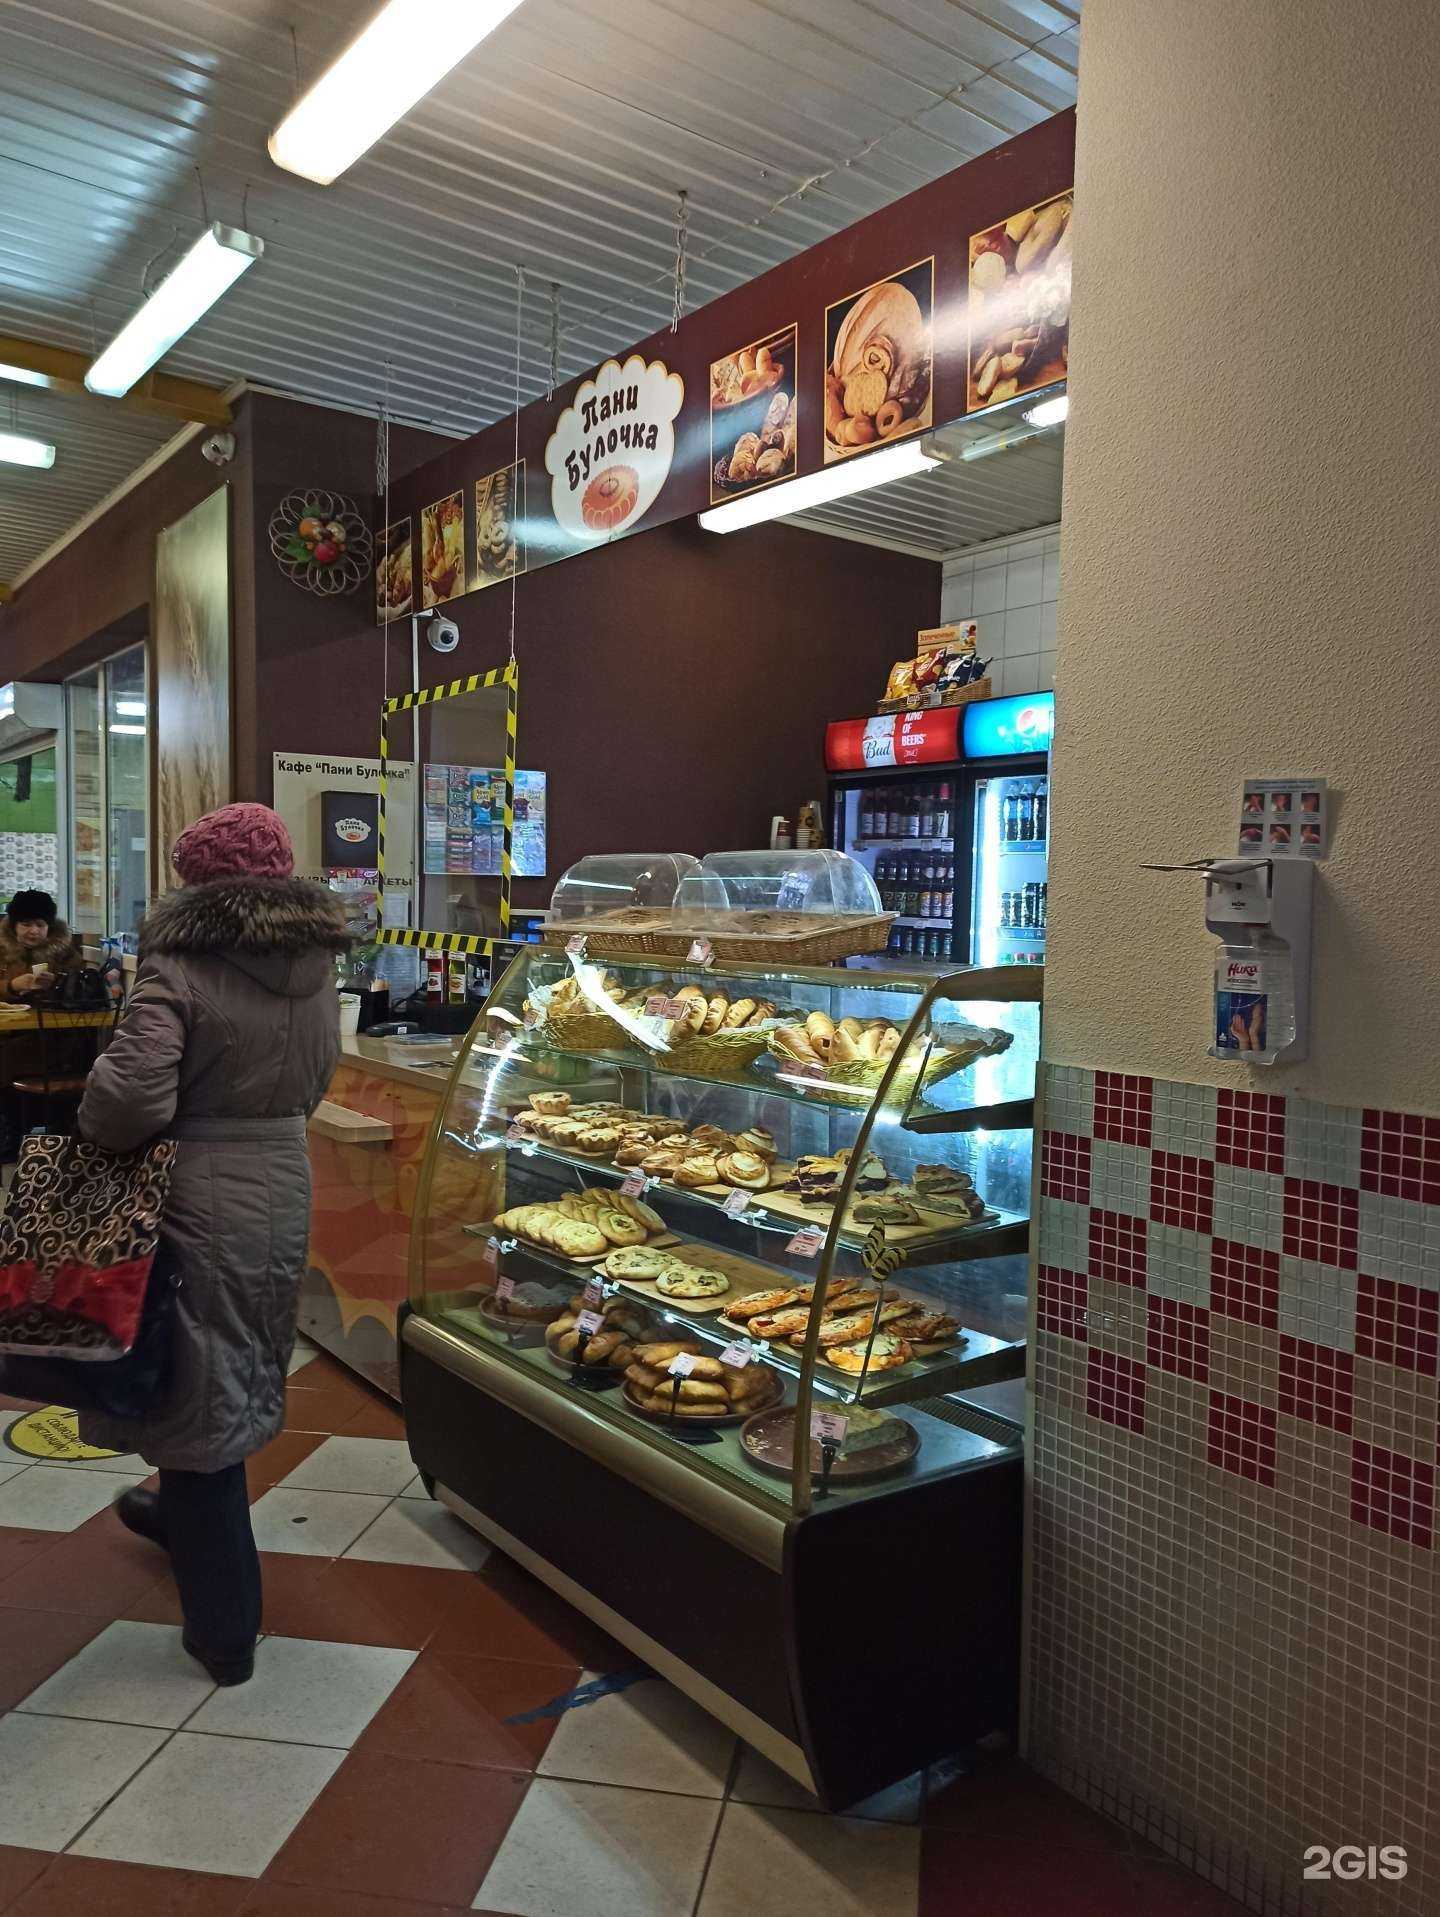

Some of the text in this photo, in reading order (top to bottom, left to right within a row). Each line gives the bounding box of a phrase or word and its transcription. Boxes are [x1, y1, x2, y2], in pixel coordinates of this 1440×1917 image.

[582, 385, 638, 433] Пани
[565, 423, 658, 491] Булочка
[905, 711, 923, 721] KING
[902, 723, 912, 733] OF
[902, 734, 925, 746] BEERS
[866, 740, 890, 759] Bud
[278, 760, 312, 774] Кафе
